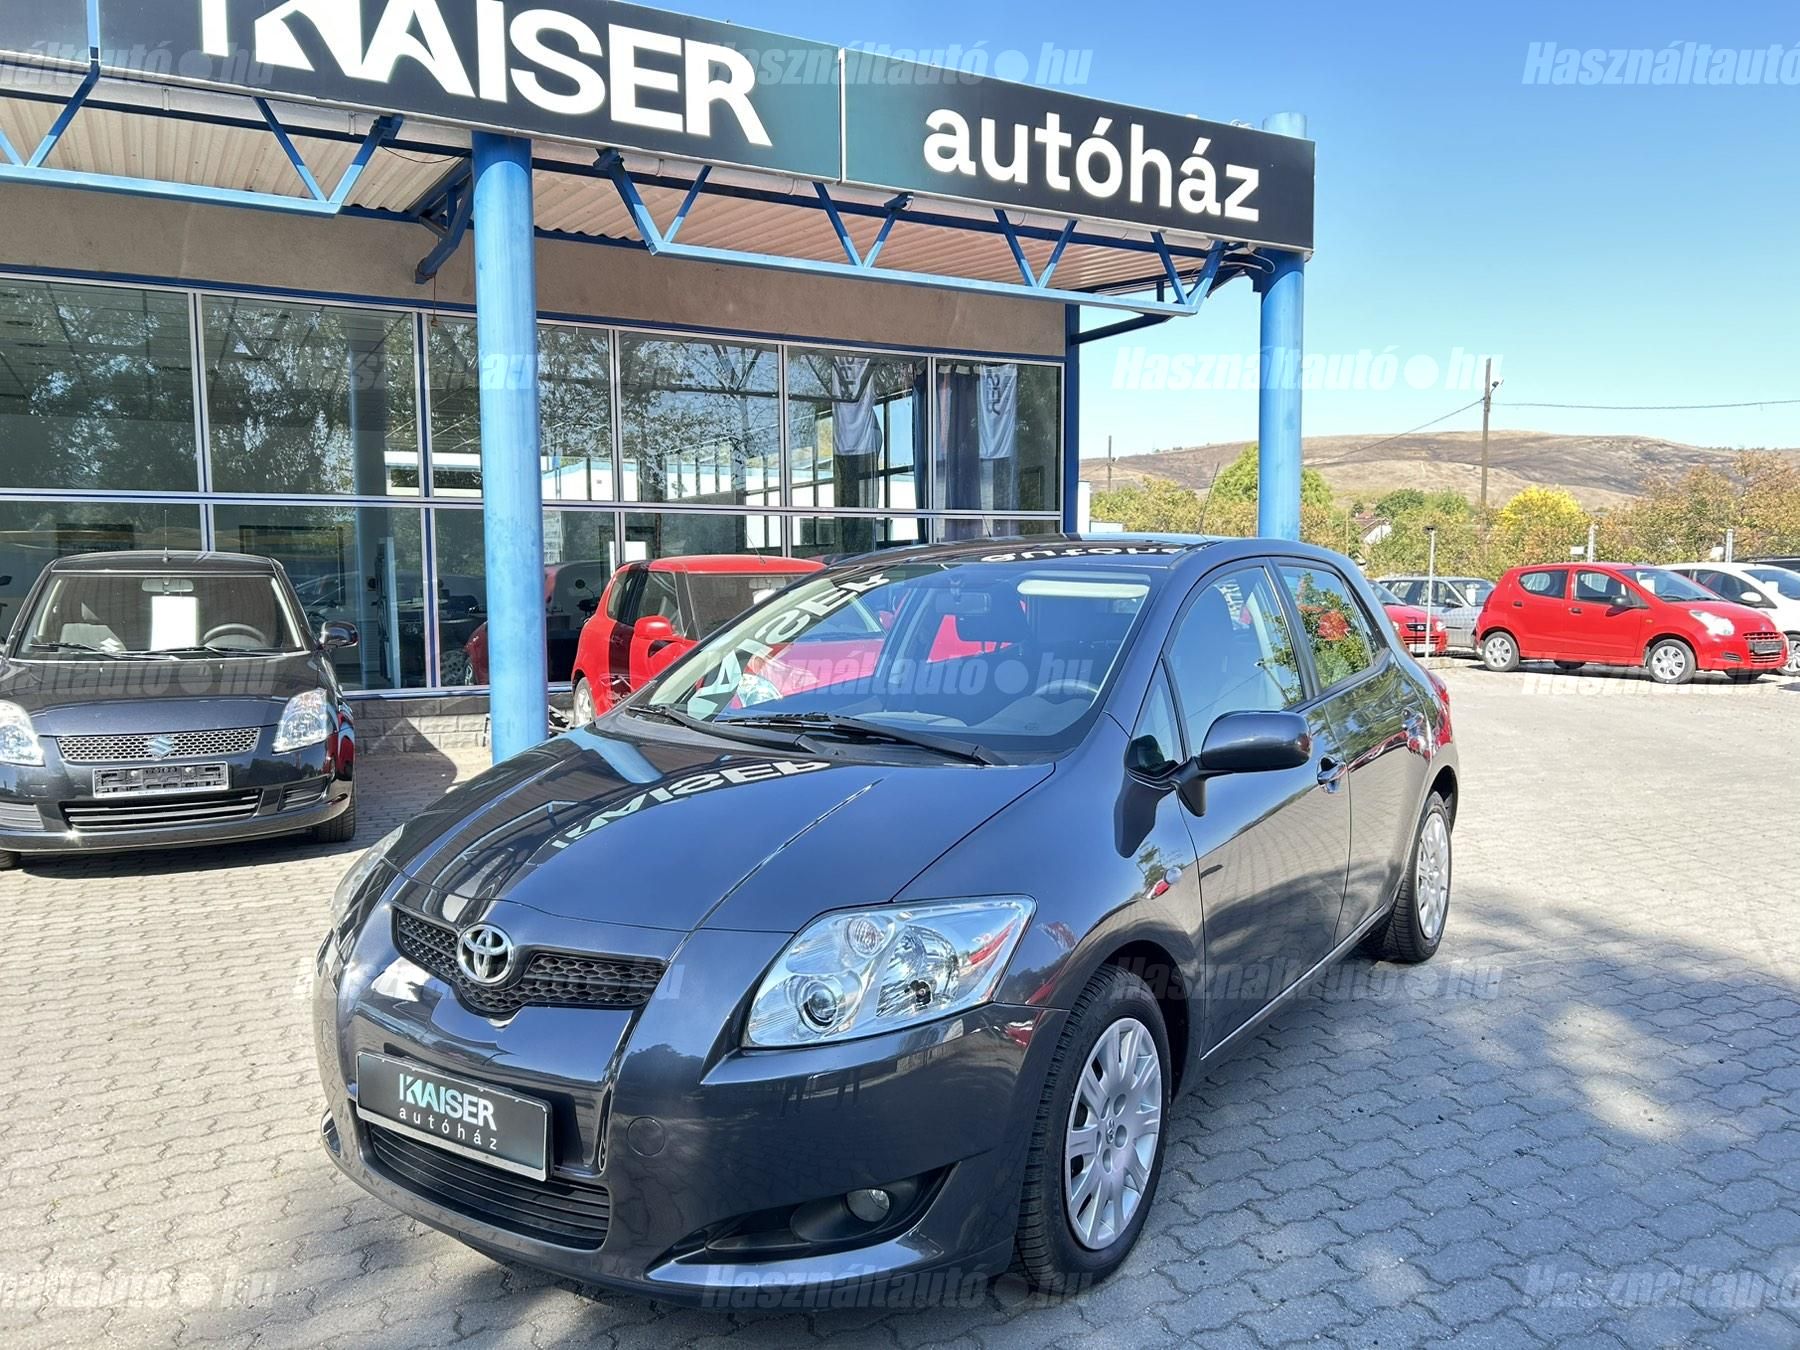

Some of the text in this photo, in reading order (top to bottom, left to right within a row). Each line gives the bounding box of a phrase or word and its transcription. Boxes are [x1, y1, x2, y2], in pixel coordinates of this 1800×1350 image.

[203, 0, 772, 146] KAISER
[923, 108, 1259, 222] autóház
[399, 1073, 497, 1131] KAISER
[399, 1107, 497, 1150] autóház
